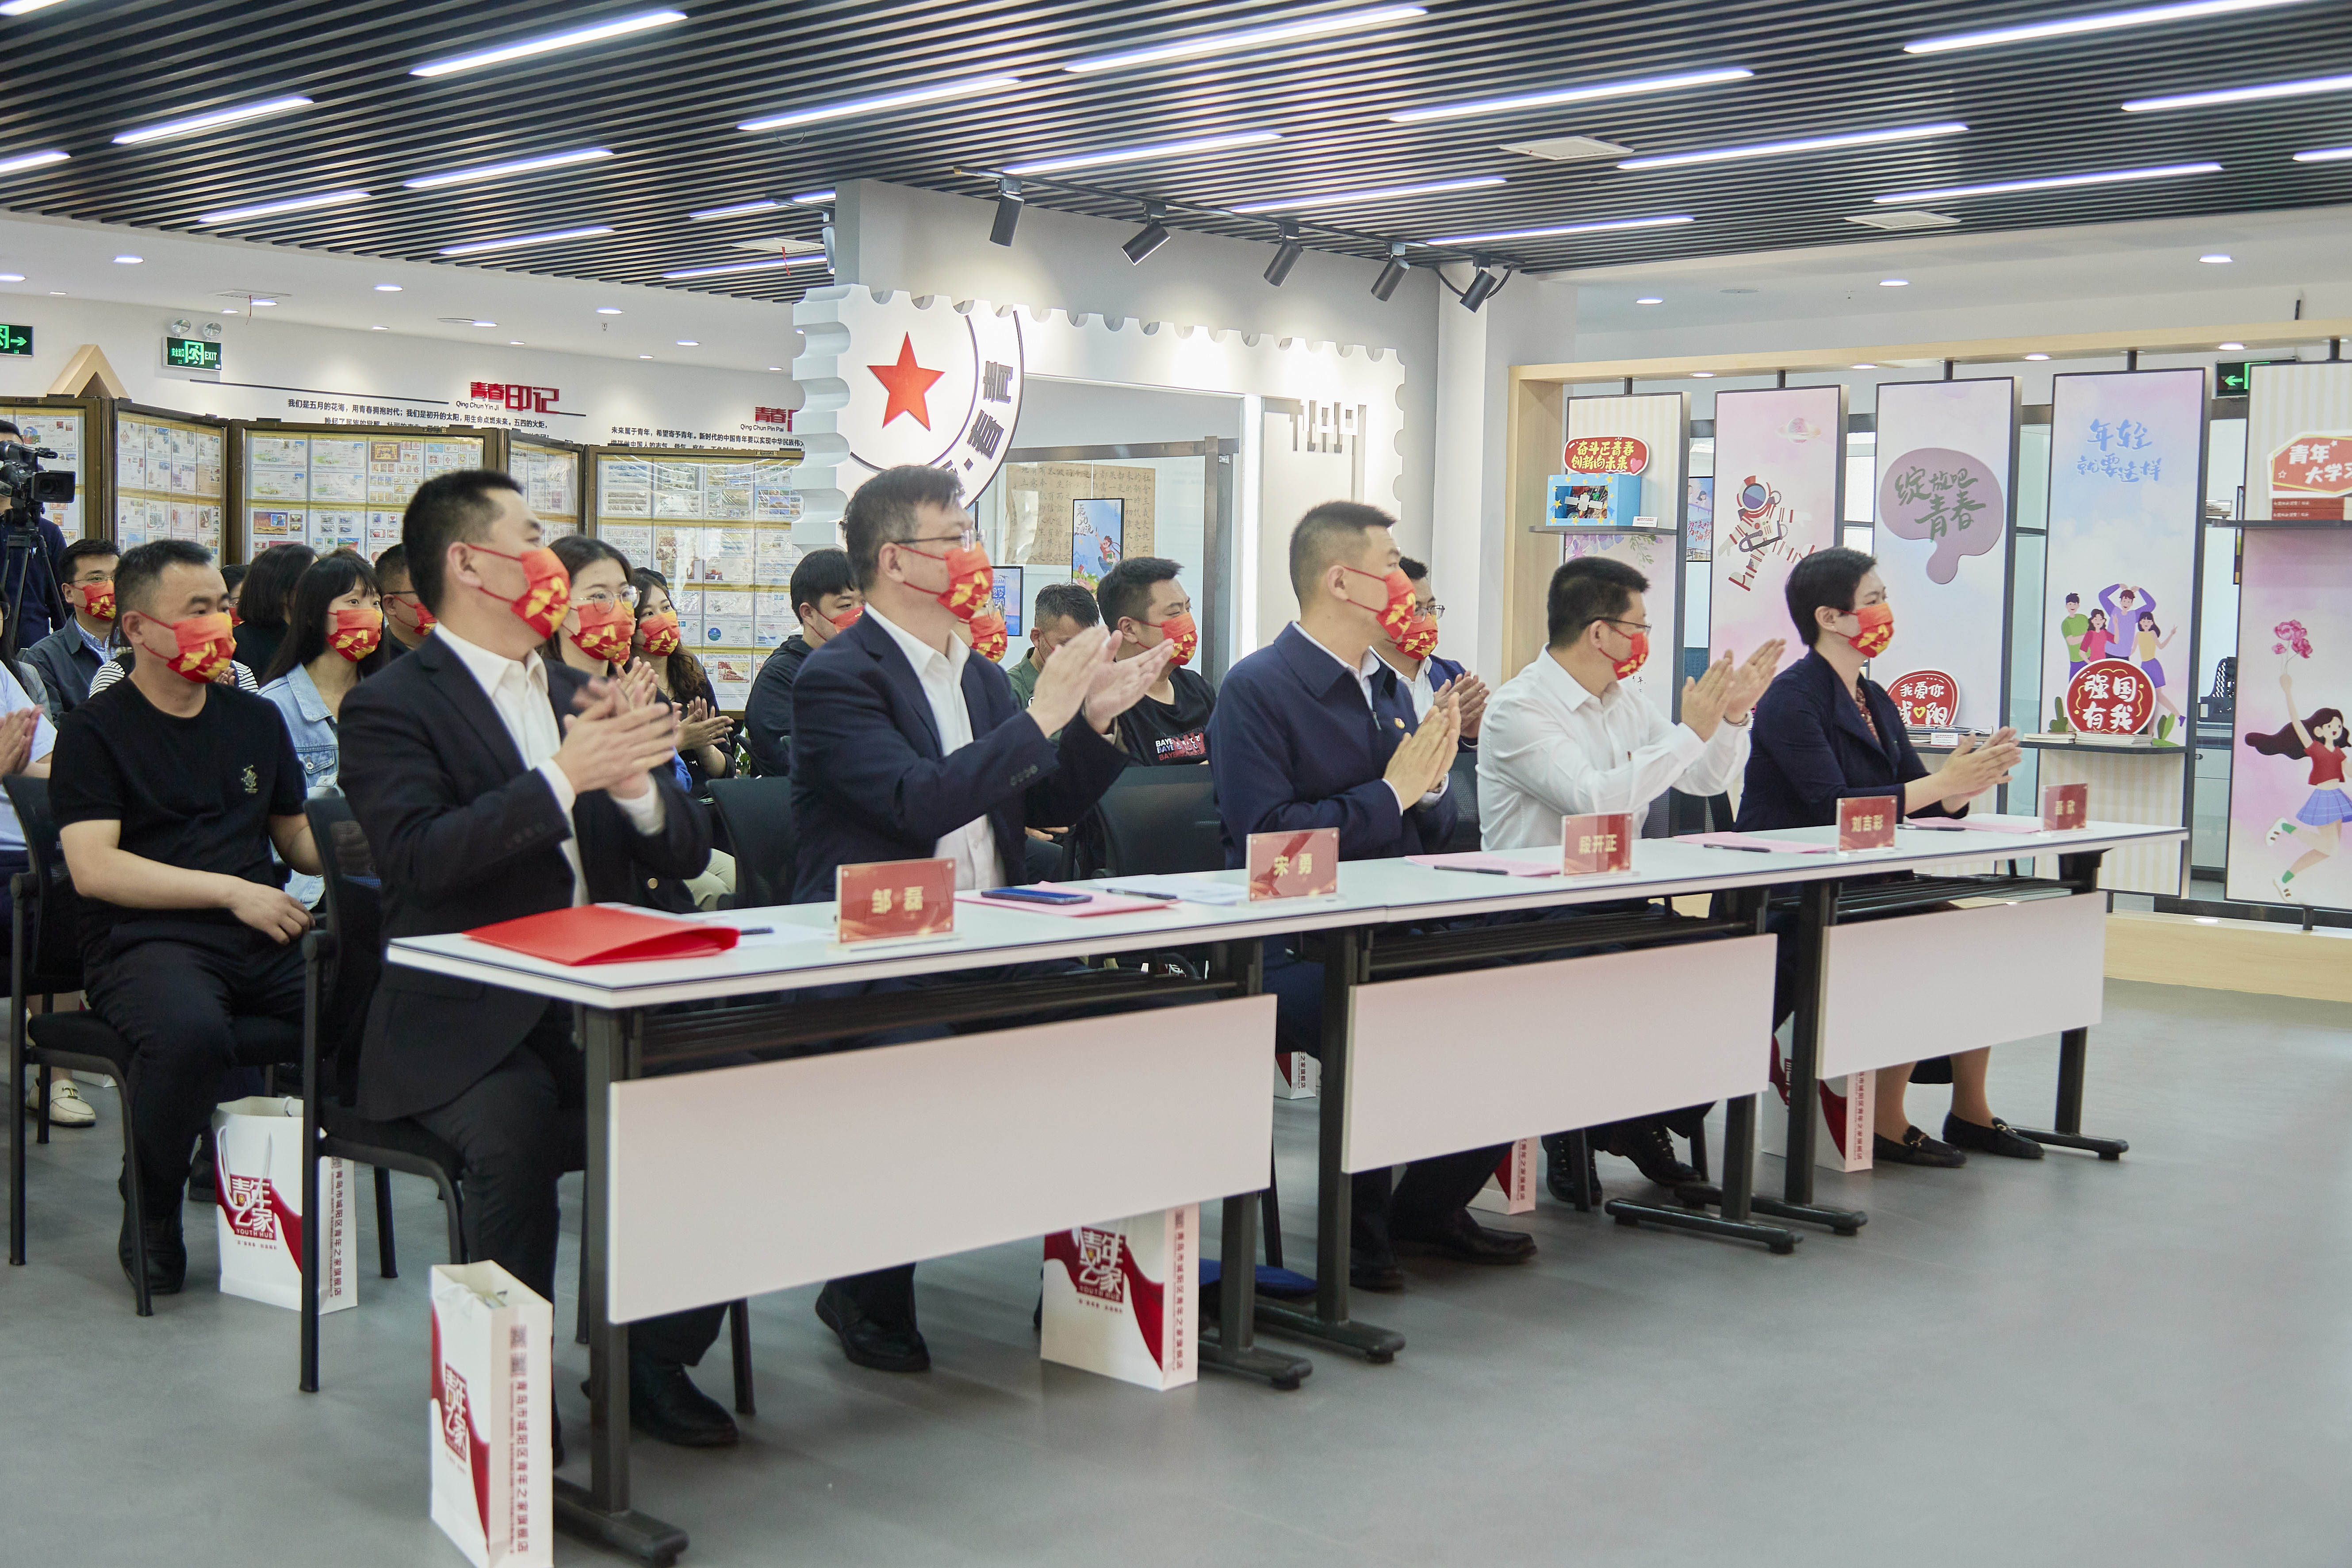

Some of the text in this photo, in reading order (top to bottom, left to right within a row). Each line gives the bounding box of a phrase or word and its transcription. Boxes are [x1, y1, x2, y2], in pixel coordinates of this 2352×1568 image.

[204, 351, 217, 361] EXIT
[471, 381, 560, 414] 青春印记
[1577, 440, 1635, 457] 奋斗正青春
[2087, 418, 2153, 452] 年轻
[1571, 454, 1628, 470] 创新向未来
[2076, 452, 2161, 483] 就要这样
[2289, 444, 2330, 464] 青年
[1895, 466, 1978, 506] 绽放吧
[1914, 490, 1986, 542] 青春
[1900, 681, 1944, 699] 我爱你
[2084, 673, 2137, 702] 强国
[2083, 701, 2133, 730] 有我
[1851, 814, 1883, 833] 刘吉彩
[1578, 834, 1617, 855] 段开正
[1273, 853, 1313, 877] 宋勇
[232, 1178, 272, 1210] 青年
[235, 1207, 273, 1233] 之家
[236, 1228, 258, 1237] YOUTH
[1082, 1231, 1123, 1263] 青年
[1080, 1264, 1122, 1294] 之家
